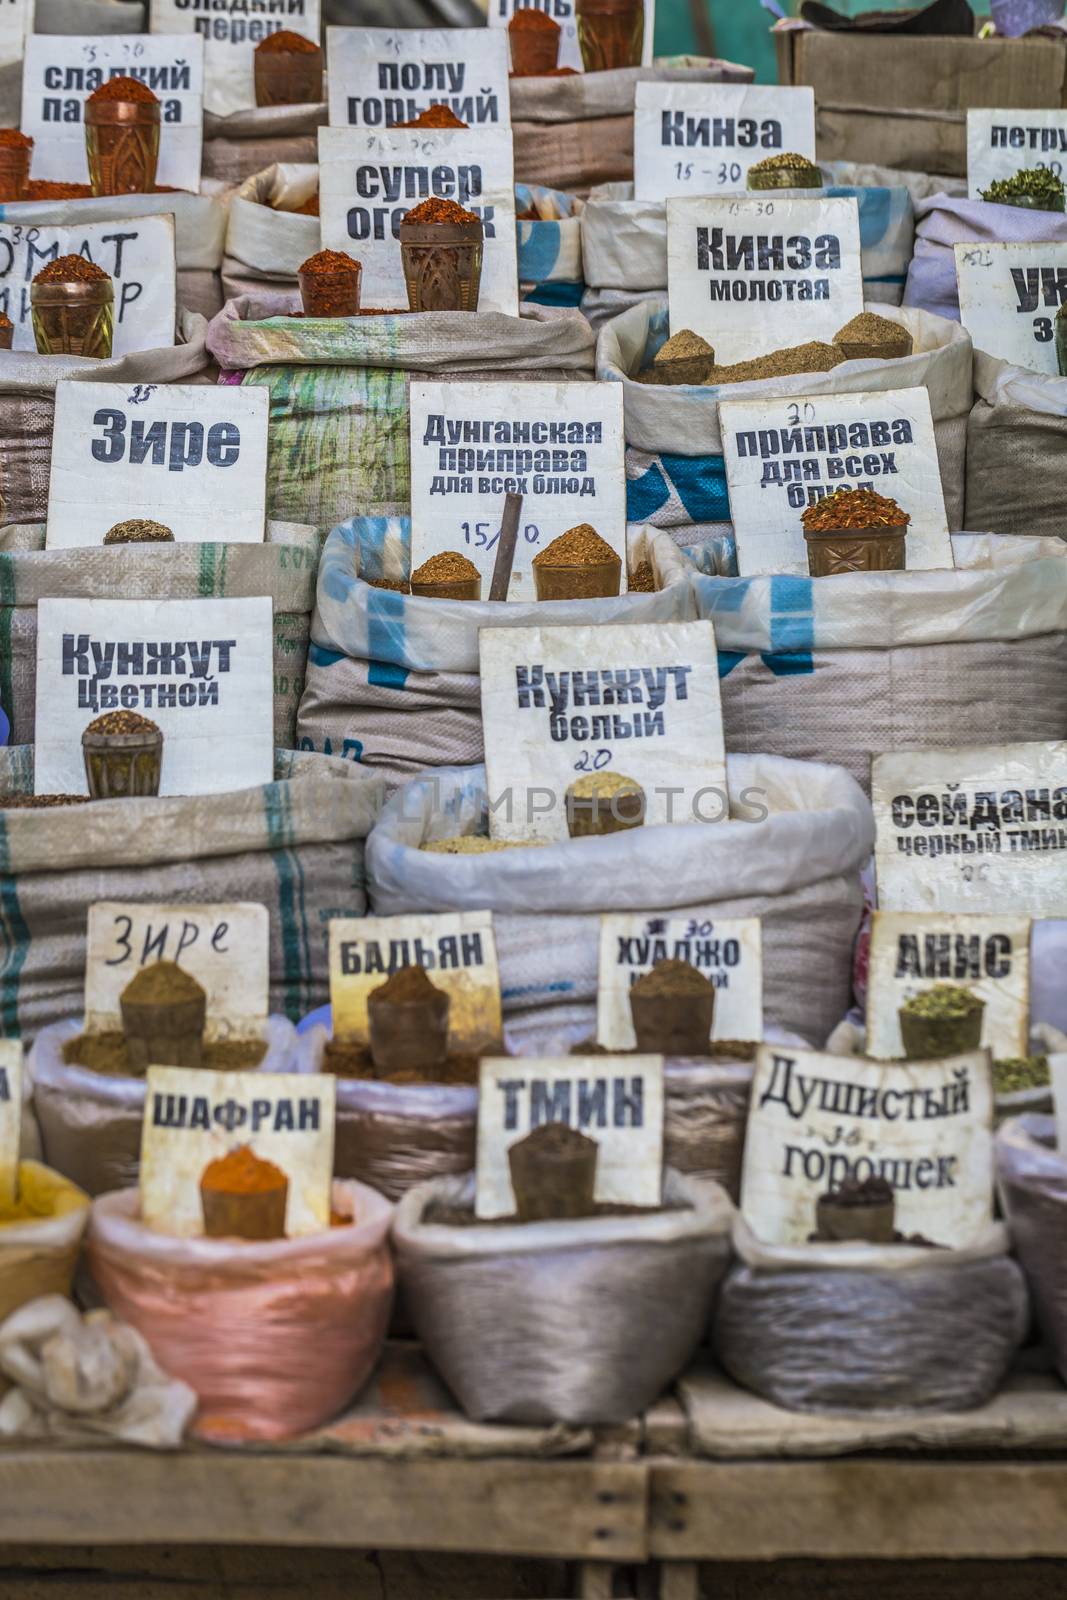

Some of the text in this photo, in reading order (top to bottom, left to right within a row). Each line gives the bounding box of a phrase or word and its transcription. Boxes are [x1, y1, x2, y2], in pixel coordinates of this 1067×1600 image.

[378, 62, 465, 93] полу
[661, 110, 782, 149] Кинза
[356, 164, 482, 204] супер
[697, 227, 841, 272] Кинза
[710, 279, 830, 302] молотая
[91, 409, 241, 471] Зире
[423, 415, 602, 446] Дунганская
[735, 418, 914, 458] приправа
[439, 448, 588, 475] приправа
[760, 452, 899, 488] для всех
[429, 474, 596, 497] для всех блюд
[62, 634, 237, 679] Кунжут
[77, 675, 220, 713] Цветной
[515, 664, 692, 712] Кунжут
[549, 705, 666, 742] белый
[573, 748, 613, 772] 20
[897, 826, 1001, 857] черный
[105, 915, 229, 966] Зире
[341, 932, 484, 976] БАДЬЯН
[894, 933, 1013, 979] АНИС
[496, 1076, 643, 1130] ТМИН
[760, 1055, 970, 1122] Душистый
[152, 1094, 320, 1132] ШАФРАН
[783, 1143, 959, 1195] горошек
